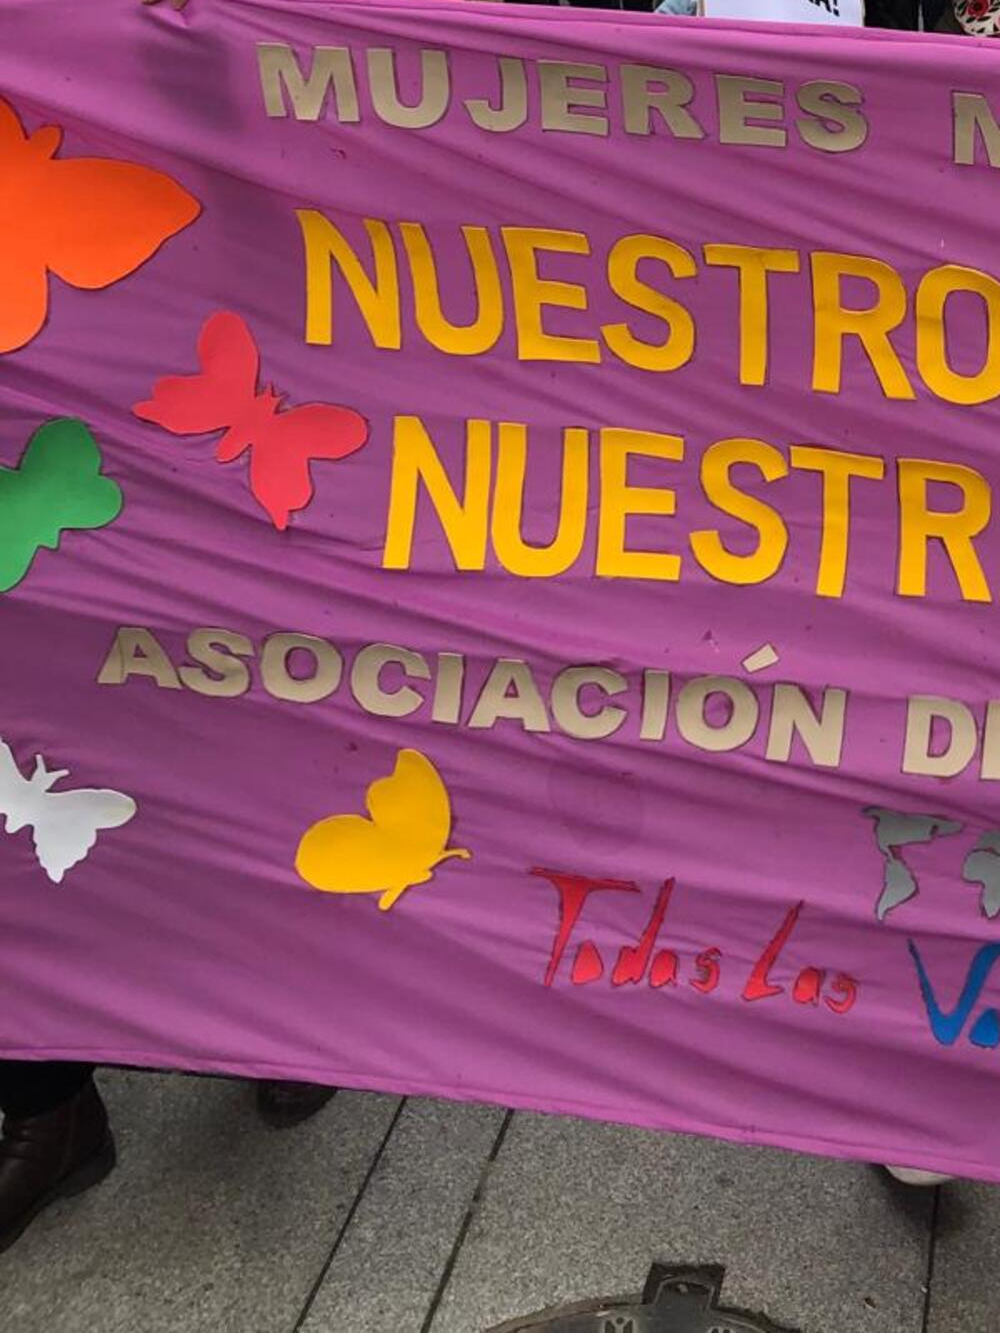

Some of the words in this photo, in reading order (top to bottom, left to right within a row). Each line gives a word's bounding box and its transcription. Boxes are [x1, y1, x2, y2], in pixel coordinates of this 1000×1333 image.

[256, 42, 869, 153] MUJERES
[97, 627, 848, 768] ASOCIACIÓN
[527, 866, 722, 988] Todas
[742, 899, 858, 1014] Las
